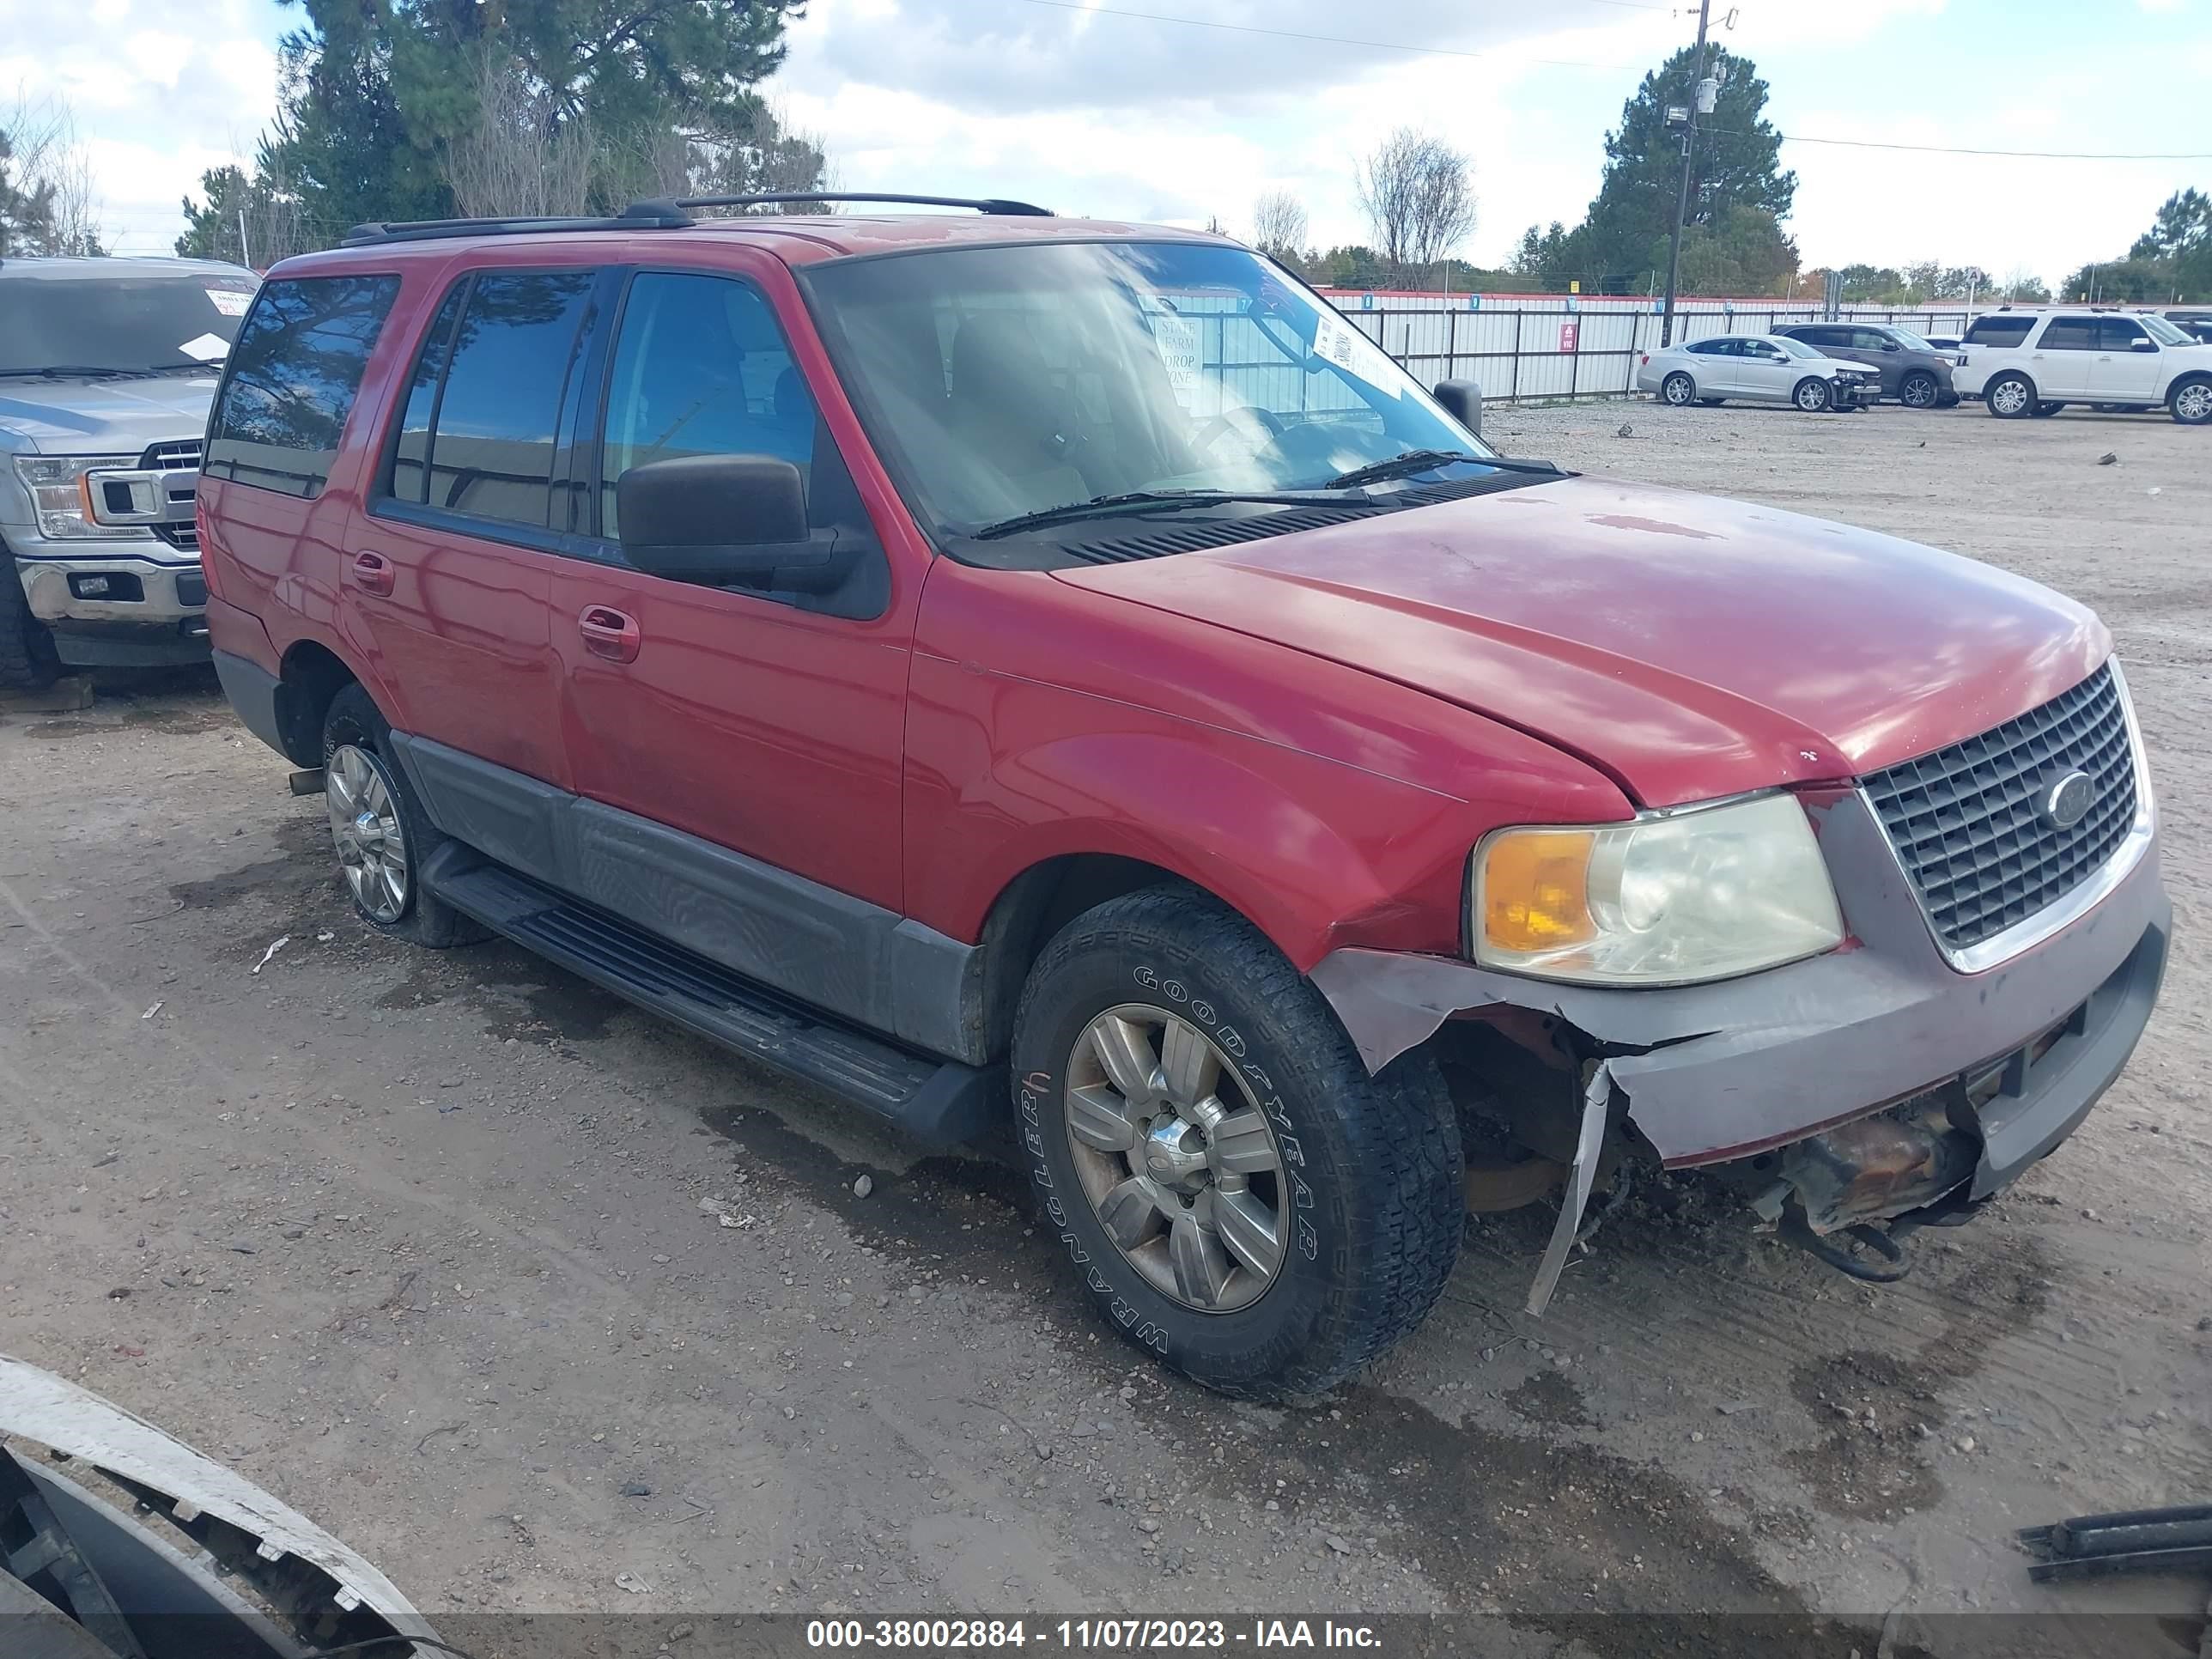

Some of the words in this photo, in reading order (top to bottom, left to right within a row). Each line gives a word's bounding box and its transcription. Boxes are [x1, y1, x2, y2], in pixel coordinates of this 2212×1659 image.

[1162, 321, 1196, 335] STATE
[1164, 337, 1194, 350] FARM
[1164, 355, 1195, 368] DROP
[1167, 370, 1194, 385] ONE
[1133, 964, 1319, 1262] GOODYEAR
[1020, 1087, 1170, 1356] WRANGLER
